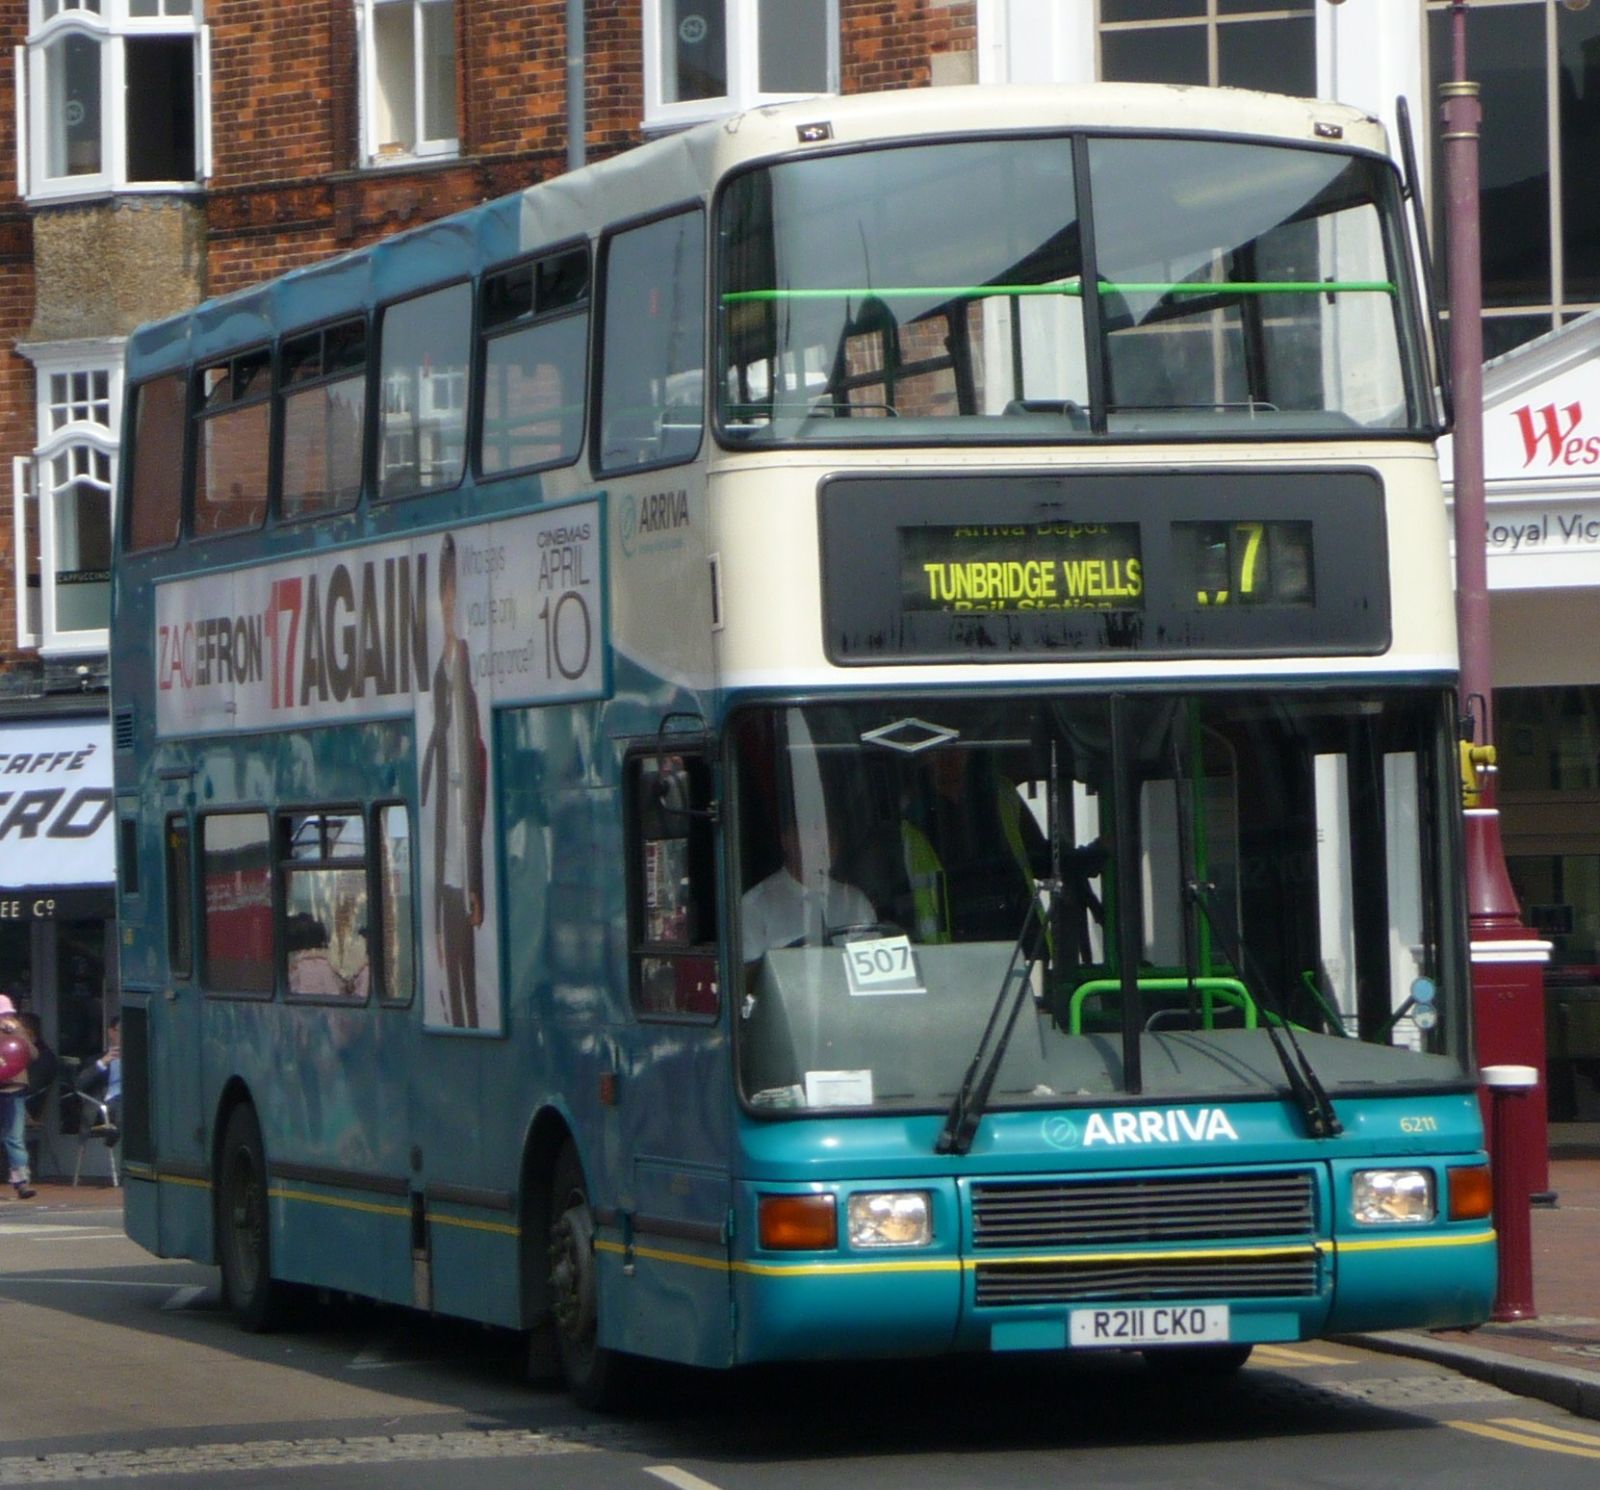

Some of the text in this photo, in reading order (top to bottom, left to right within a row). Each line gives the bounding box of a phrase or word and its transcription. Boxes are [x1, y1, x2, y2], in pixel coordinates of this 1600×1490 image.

[1510, 401, 1600, 469] Wes
[639, 490, 690, 533] ARRIVA
[536, 523, 591, 548] CINEMAS
[1486, 514, 1548, 552] oyal
[538, 547, 591, 591] APRIL
[1236, 522, 1264, 592] 7
[924, 559, 1141, 600] TUNBRIDGE WELLS
[158, 552, 431, 710] ZAC EFRON 17 AGAIN
[539, 590, 592, 681] 10
[855, 946, 909, 977] 507
[1083, 1108, 1239, 1147] ARRIVA
[1401, 1115, 1438, 1133] 6211
[1094, 1308, 1206, 1338] R211 CKO
